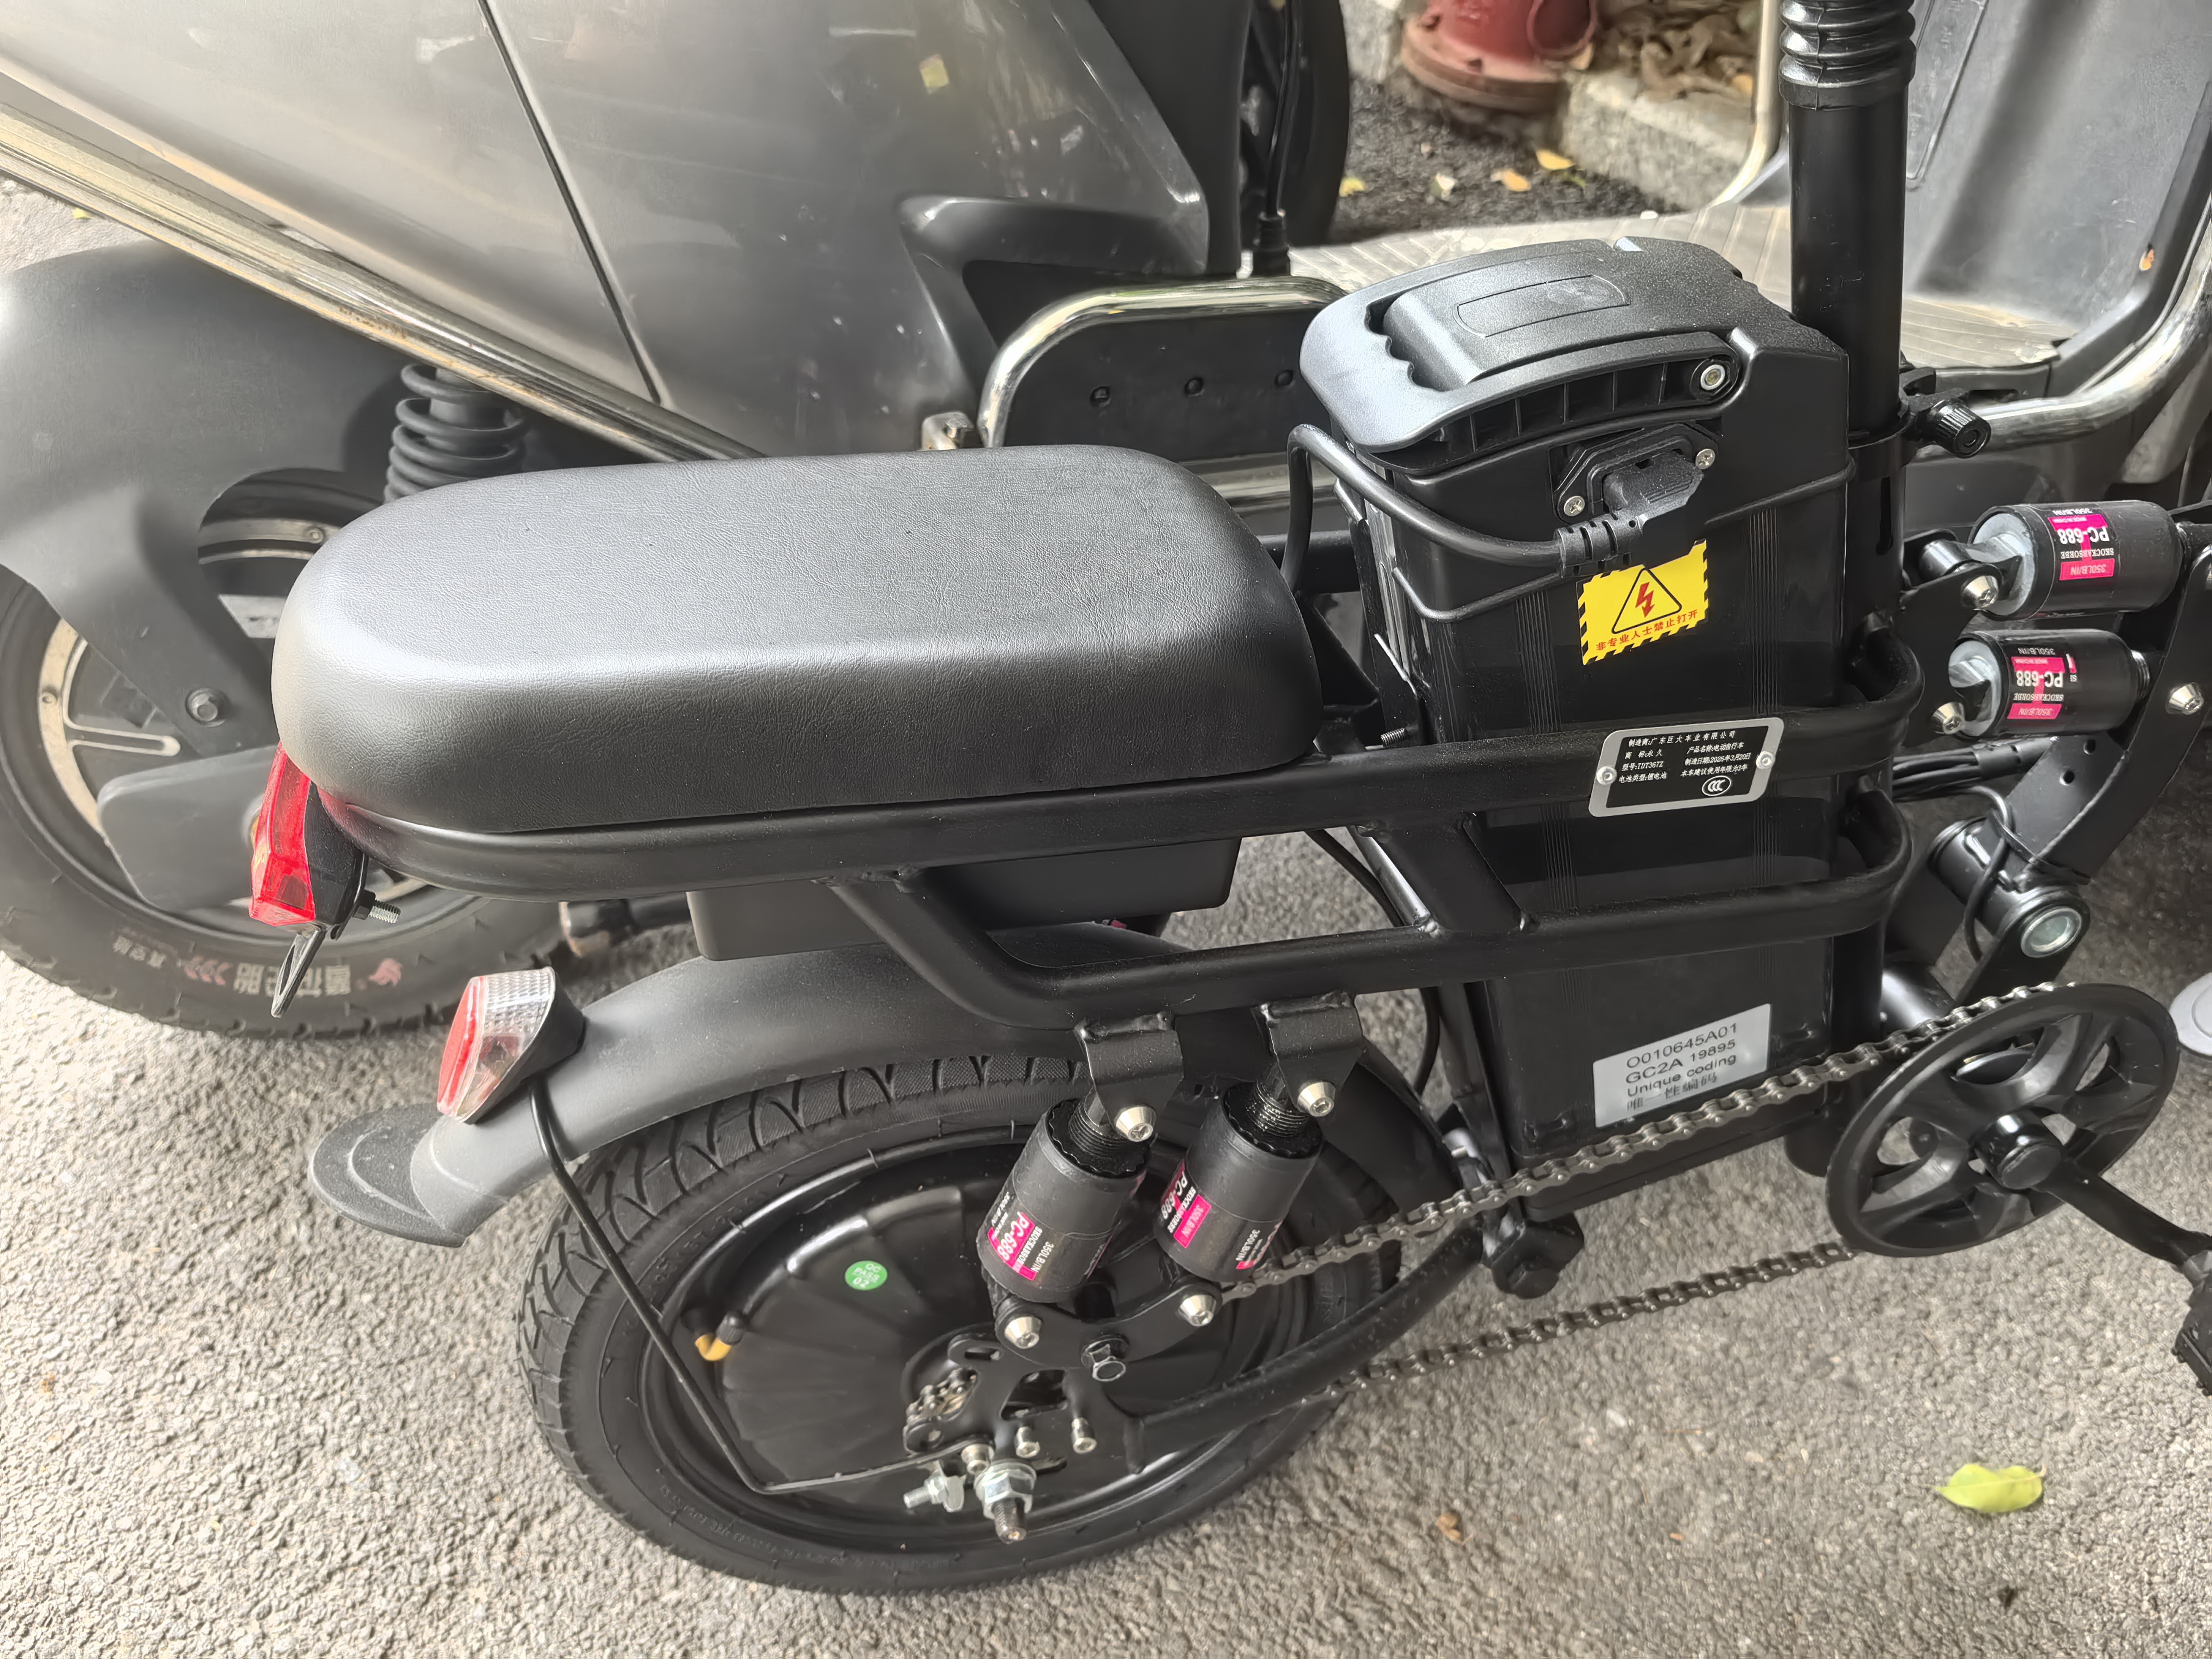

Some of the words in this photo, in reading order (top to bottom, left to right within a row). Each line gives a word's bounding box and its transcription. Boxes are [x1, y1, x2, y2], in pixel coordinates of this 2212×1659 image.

[2057, 526, 2109, 544] PC-688
[2060, 548, 2114, 559] SKOCKABSORBE
[2070, 564, 2106, 575] 350LB/IN
[1596, 609, 1698, 651] 非专业人士禁止打开
[2016, 671, 2063, 688] PC-688
[2019, 708, 2052, 716] 350LB/IN
[1626, 1058, 1683, 1084] GC2A
[1689, 1039, 1735, 1062] 19895
[1627, 1074, 1681, 1097] Unique
[1687, 1054, 1736, 1077] coding
[1161, 1171, 1188, 1220] PC-688
[997, 1211, 1030, 1261] PC-688
[866, 1263, 881, 1273] QC
[1030, 1241, 1054, 1273] 350LB/IN
